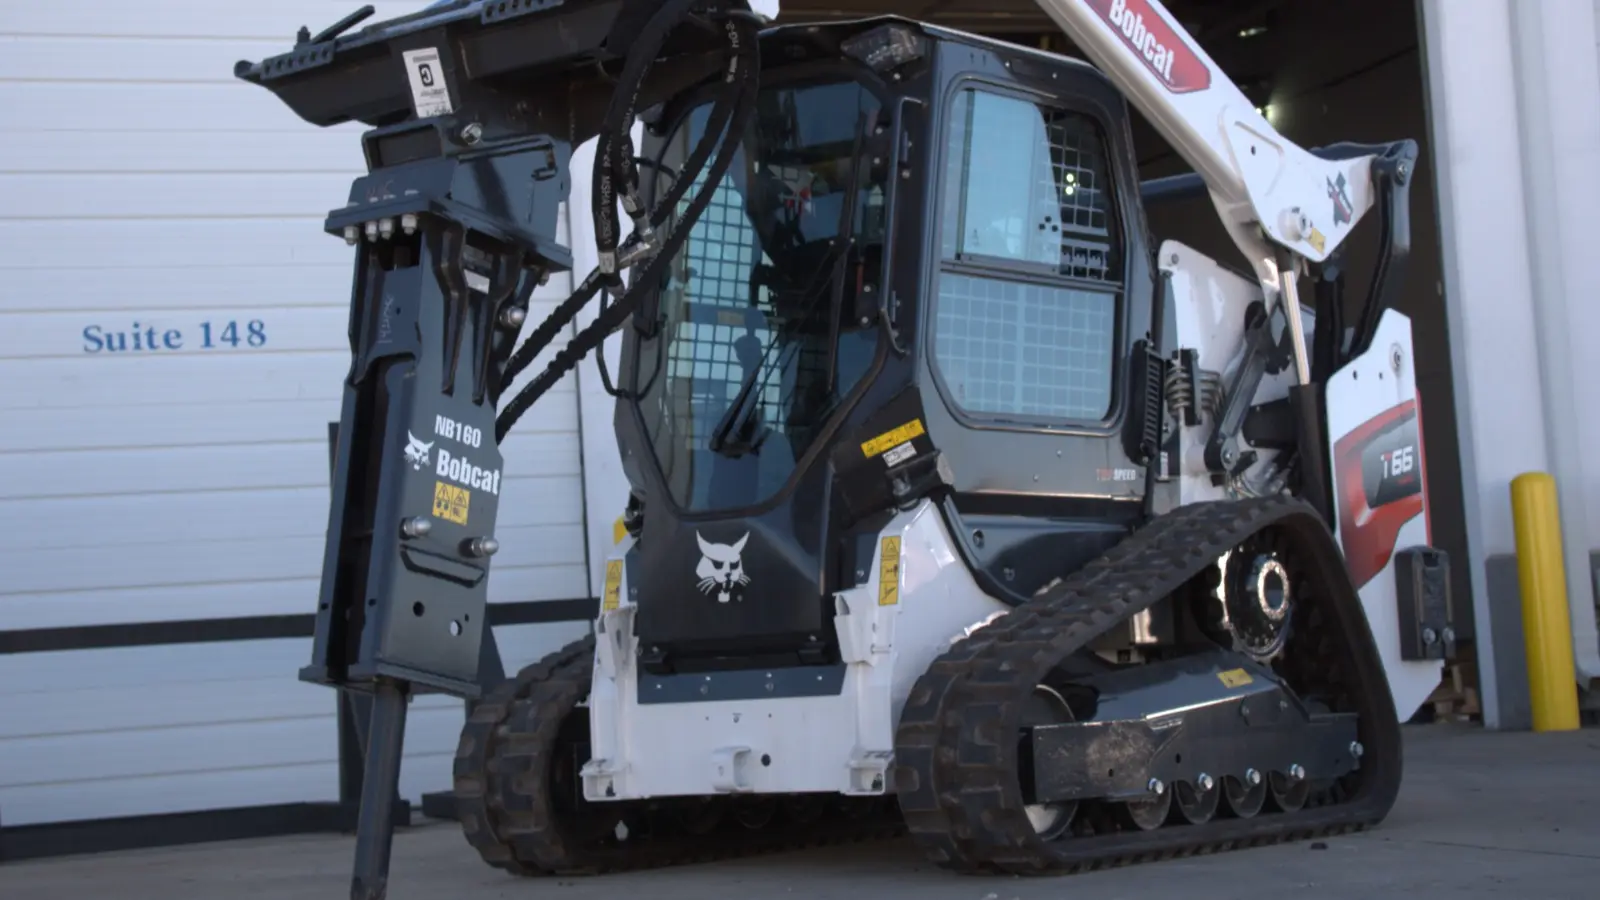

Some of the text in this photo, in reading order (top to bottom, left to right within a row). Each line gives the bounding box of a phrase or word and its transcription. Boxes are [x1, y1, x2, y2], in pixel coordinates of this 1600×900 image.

[1109, 0, 1174, 80] Bobcat
[82, 319, 267, 353] Suite 148
[434, 414, 482, 448] NB160
[436, 447, 500, 496] Bobcat
[1380, 446, 1413, 479] T66
